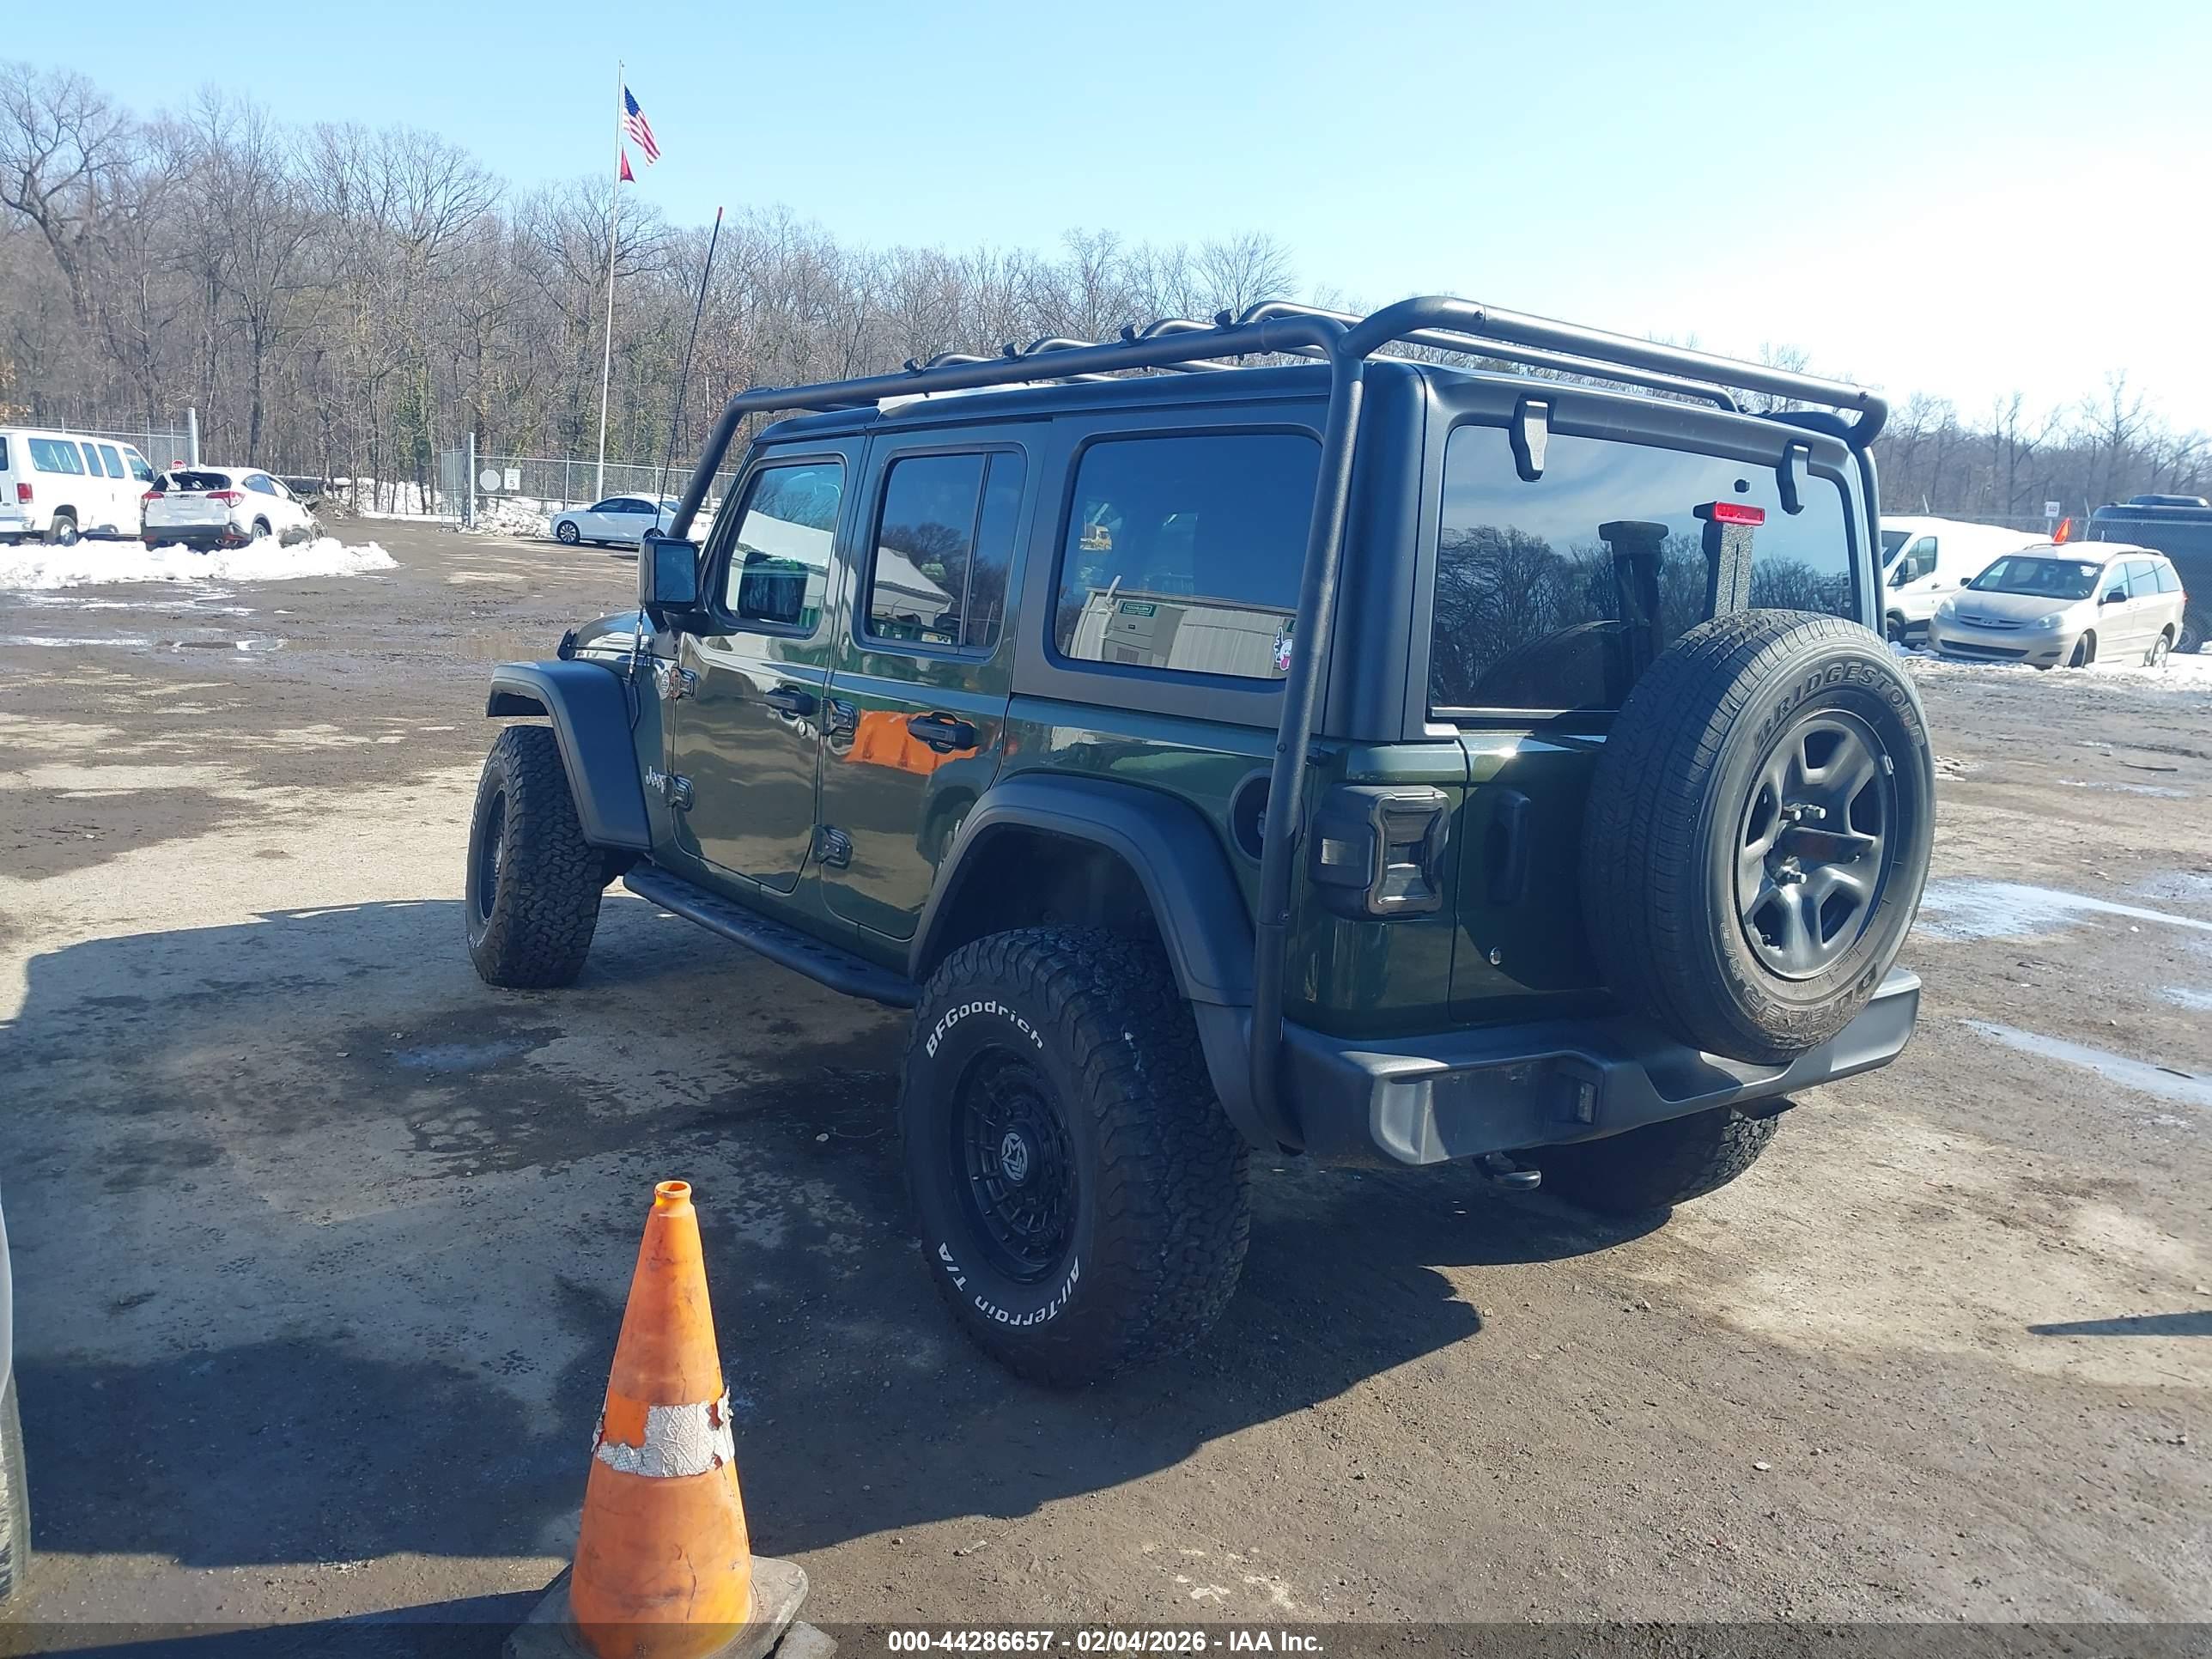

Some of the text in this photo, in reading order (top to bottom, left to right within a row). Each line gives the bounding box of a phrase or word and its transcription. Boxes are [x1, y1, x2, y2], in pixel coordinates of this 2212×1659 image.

[509, 479, 515, 488] 5
[1753, 661, 1925, 750] BRIDGESTONE
[645, 765, 666, 794] Jeep
[926, 1000, 1043, 1058] BFGoodrich
[939, 1242, 1081, 1326] All-Terrain T/A
